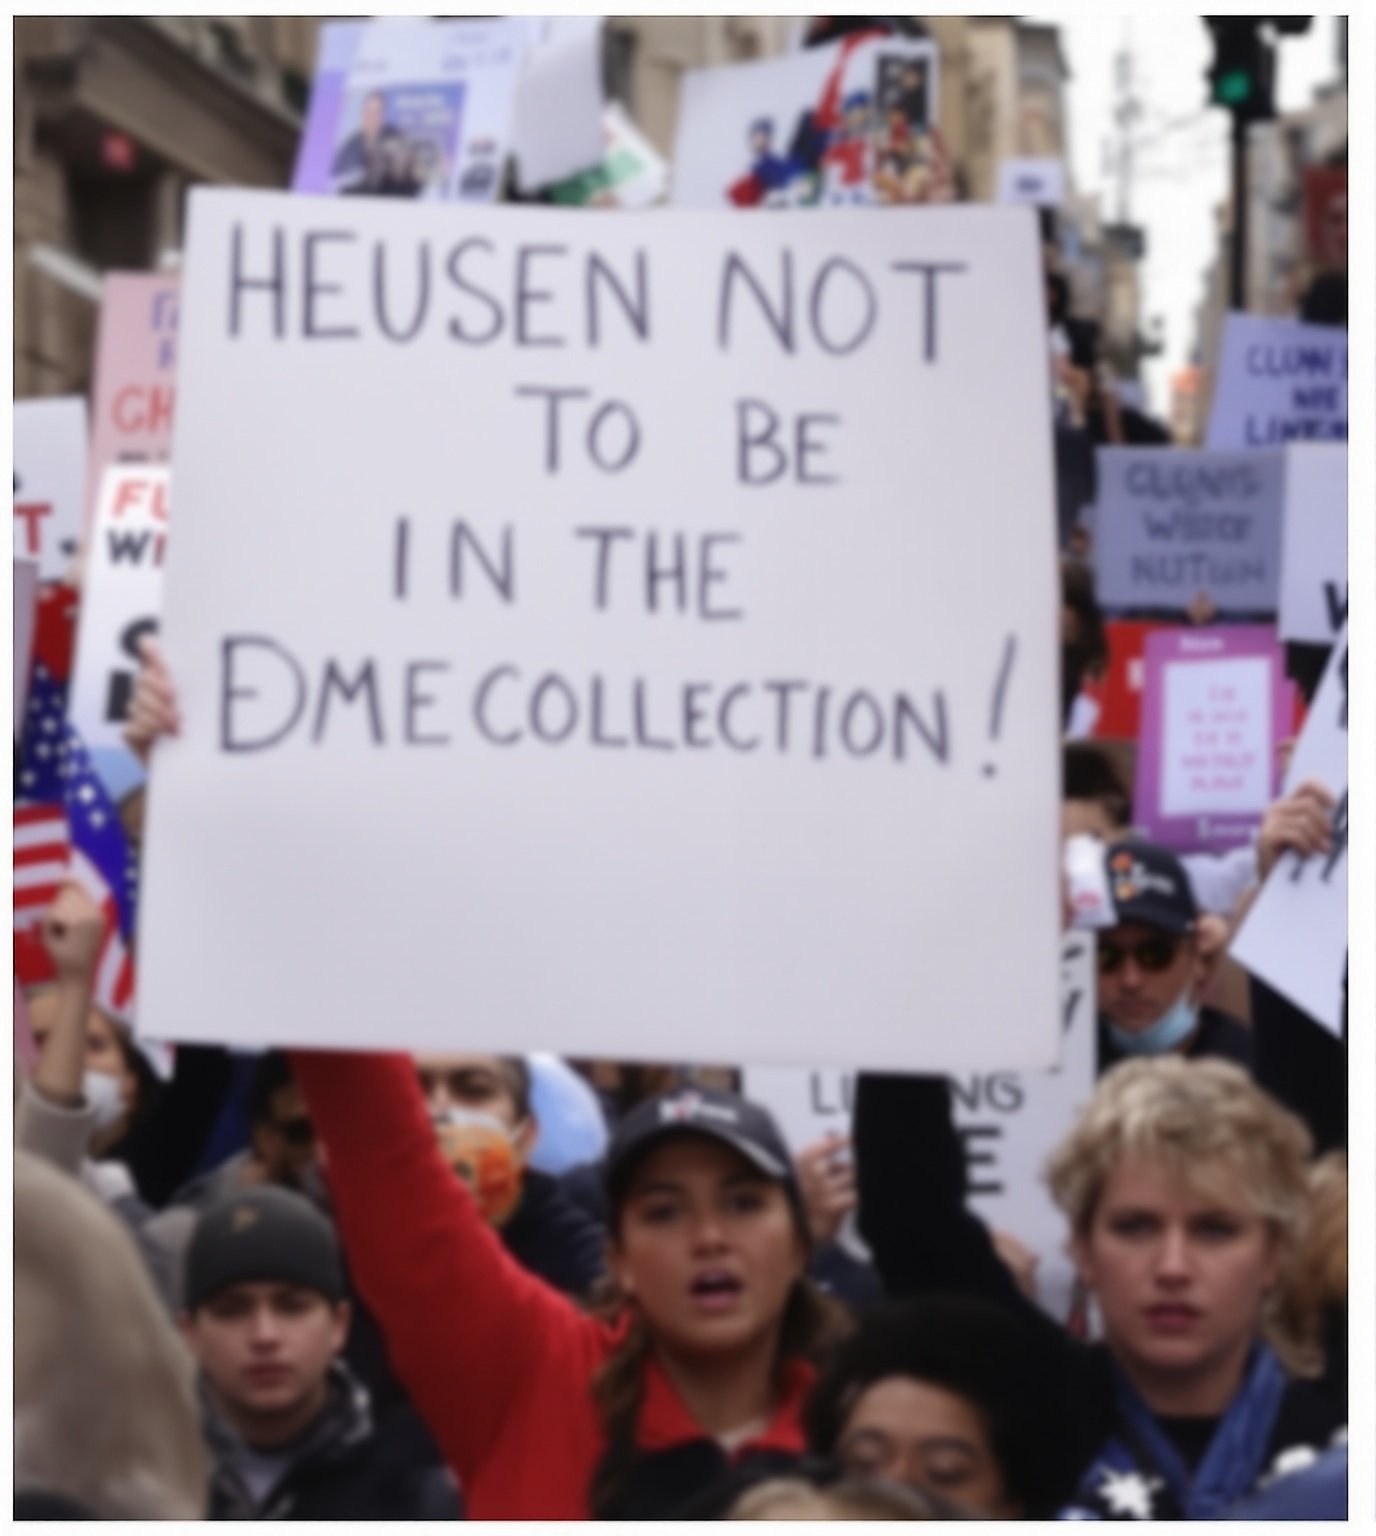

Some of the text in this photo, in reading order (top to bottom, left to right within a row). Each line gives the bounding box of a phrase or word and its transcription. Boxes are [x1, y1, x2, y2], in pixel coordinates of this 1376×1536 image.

[227, 220, 970, 365] HEUSEN NOT
[513, 384, 844, 487] TO BE
[394, 515, 744, 621] IN THE
